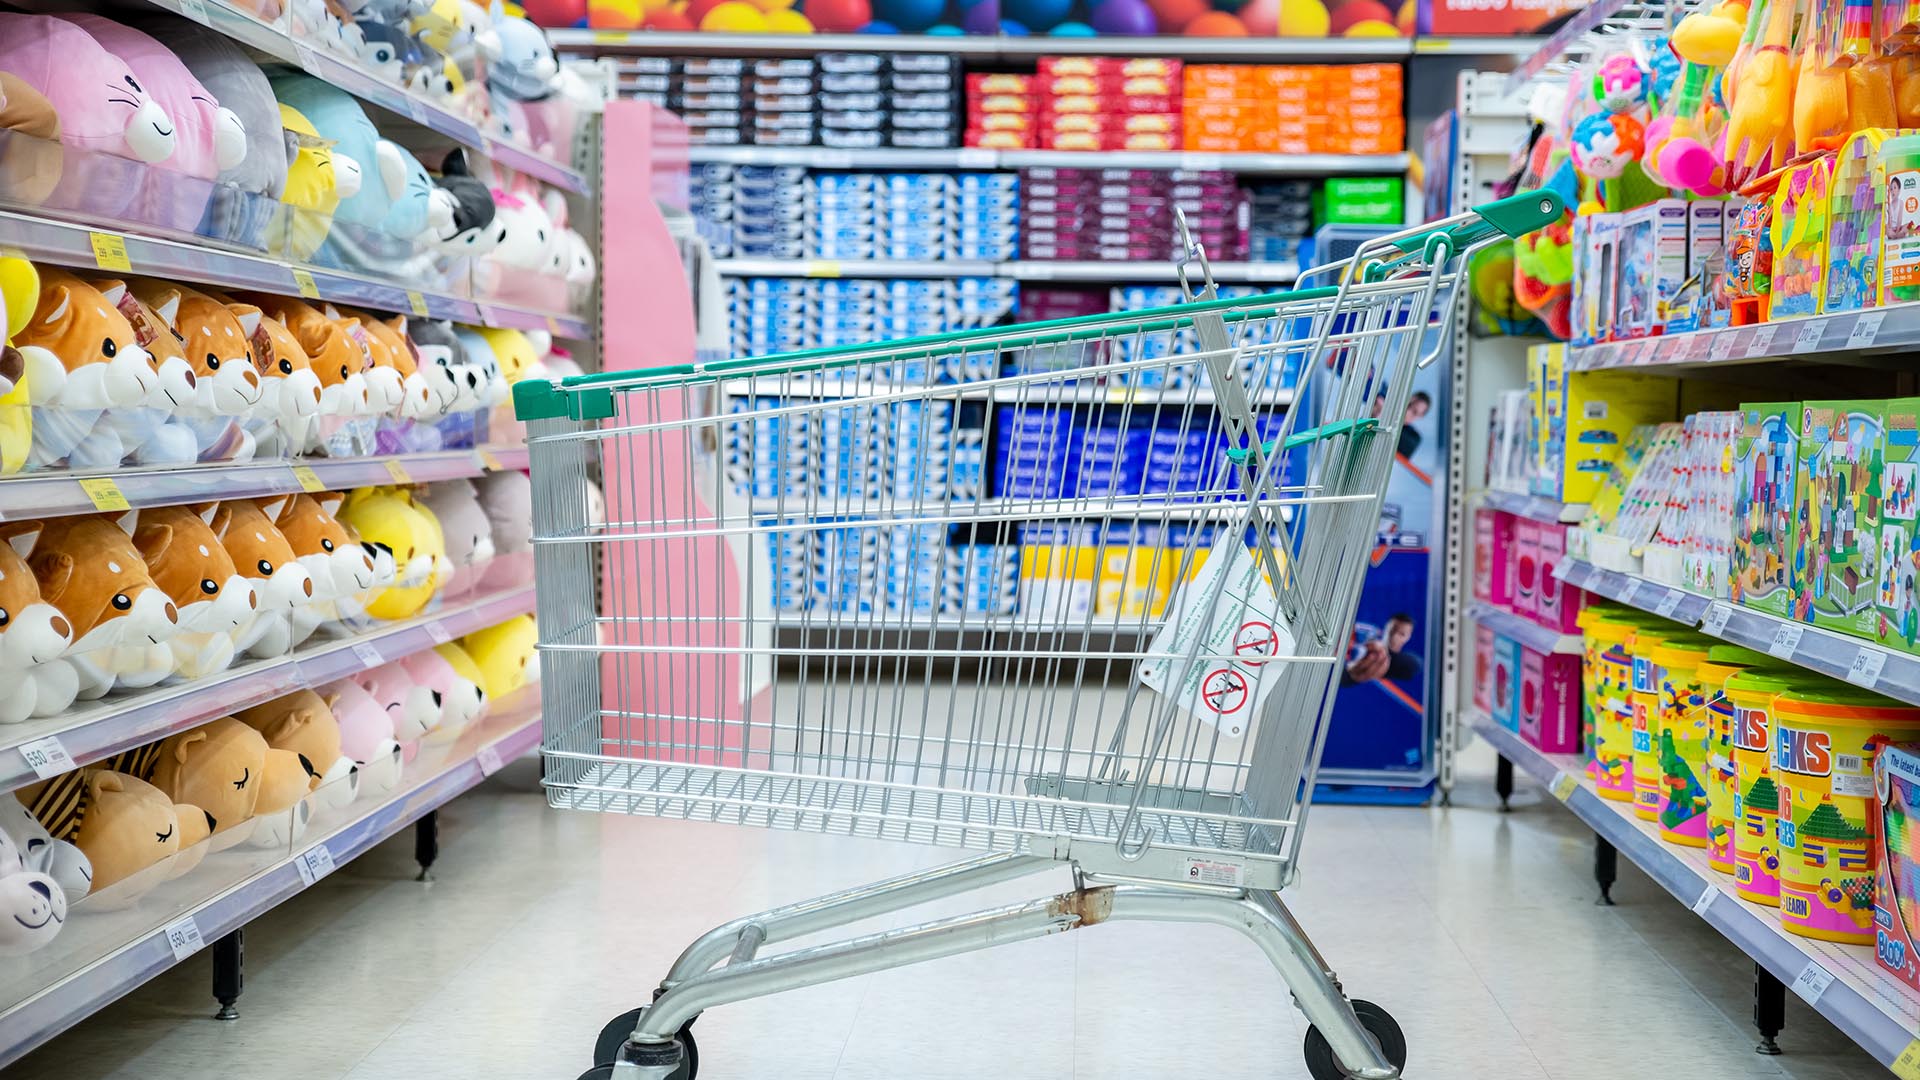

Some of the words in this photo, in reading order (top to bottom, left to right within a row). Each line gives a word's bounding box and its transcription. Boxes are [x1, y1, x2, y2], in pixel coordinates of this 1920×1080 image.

[26, 750, 48, 767] 550
[1891, 753, 1900, 768] The
[1900, 757, 1915, 775] latest
[1785, 895, 1807, 916] LEARN
[171, 930, 185, 948] 550
[1800, 968, 1817, 985] 200
